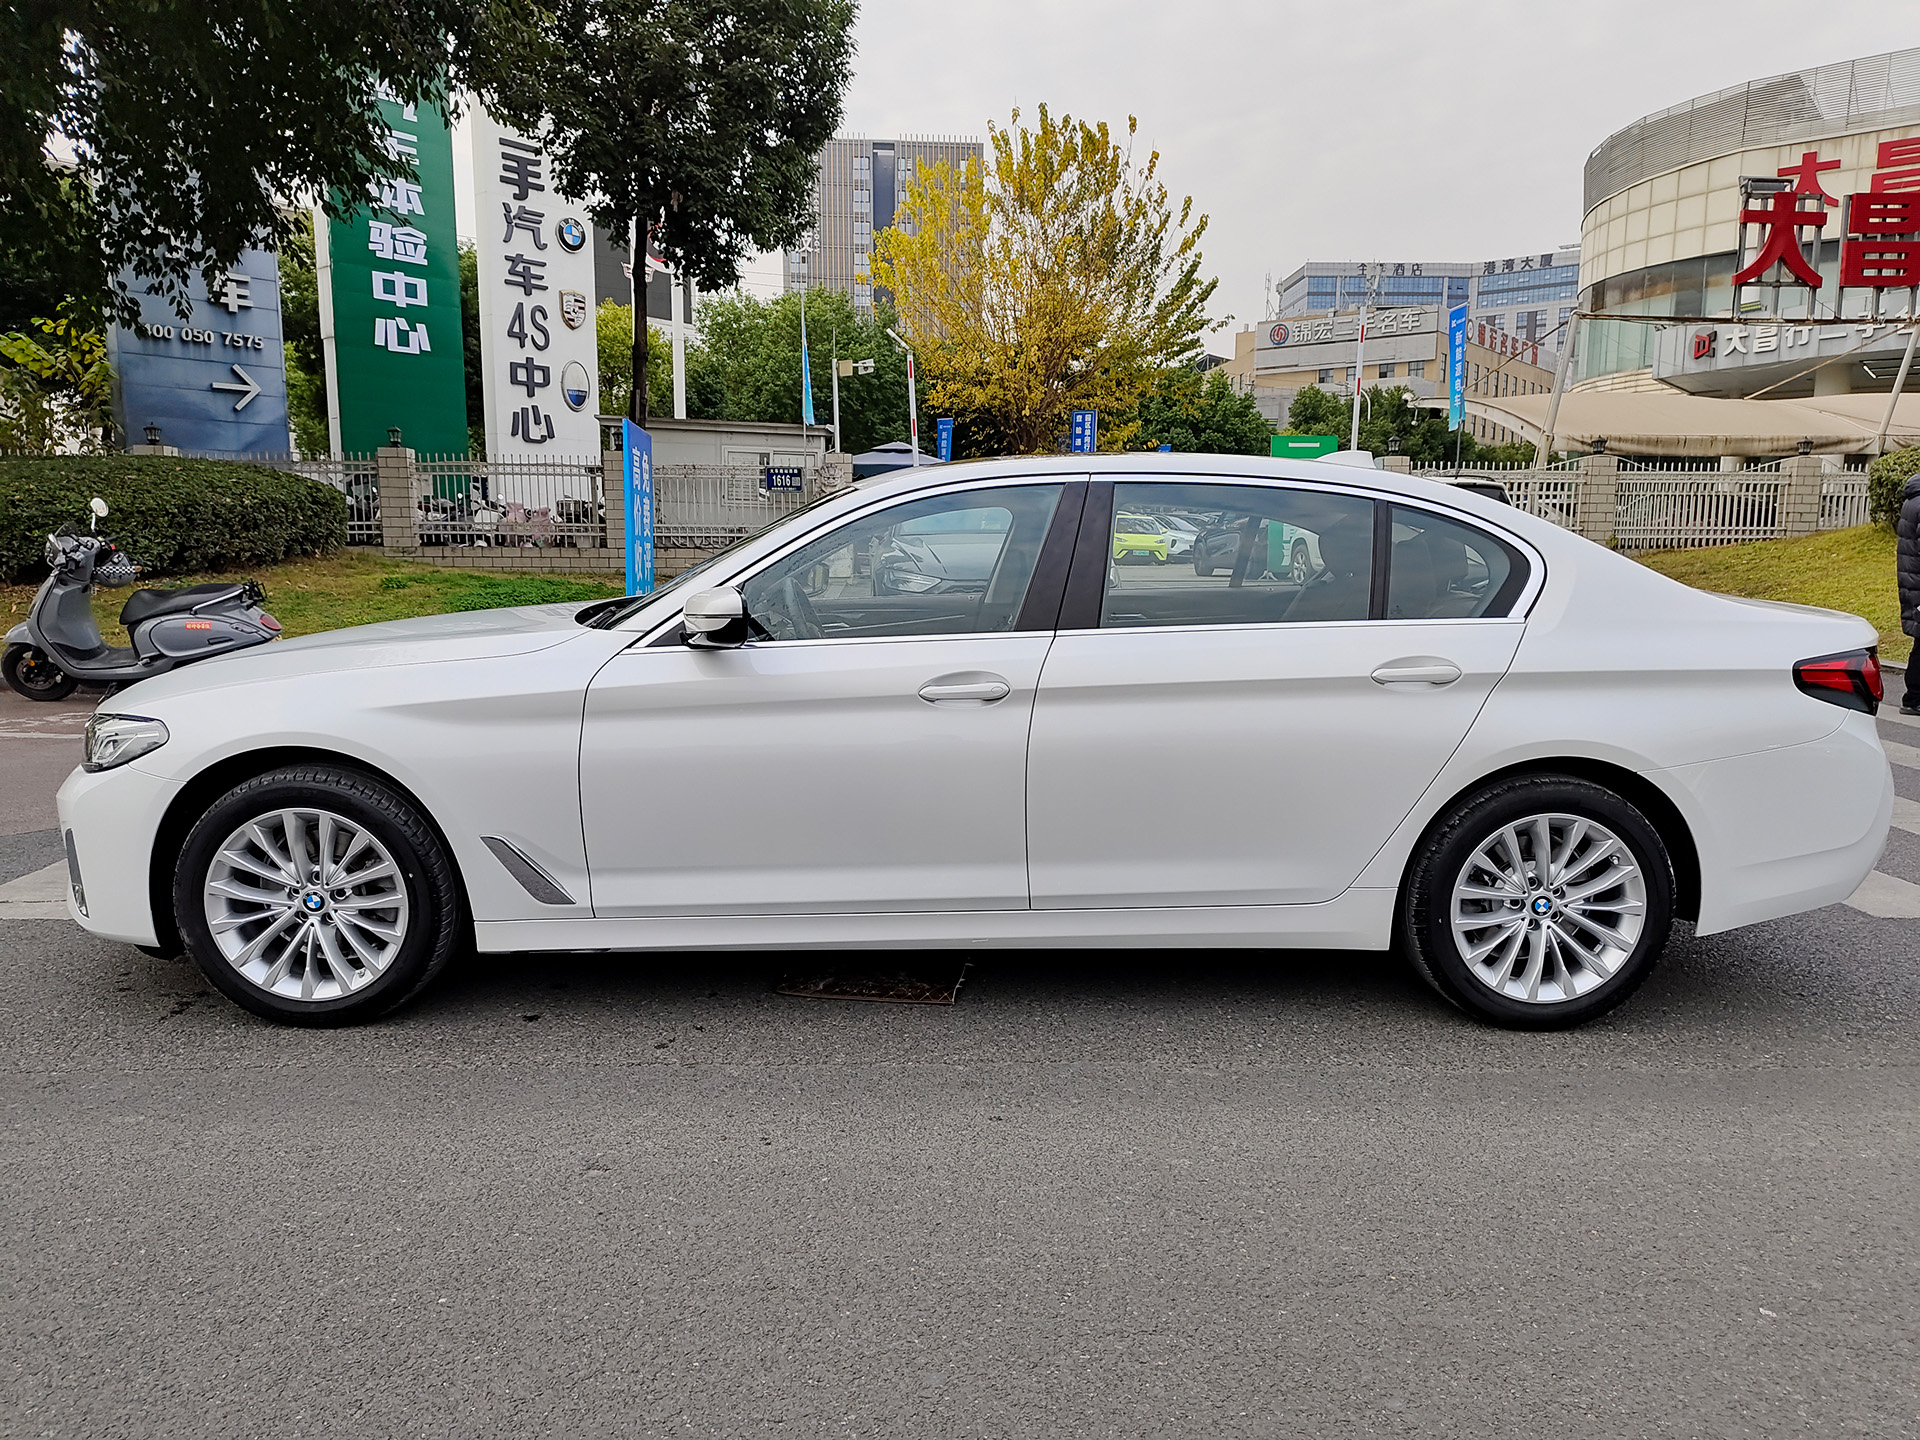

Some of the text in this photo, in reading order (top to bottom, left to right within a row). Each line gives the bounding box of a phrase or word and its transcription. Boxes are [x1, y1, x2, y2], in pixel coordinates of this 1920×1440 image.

[1357, 263, 1422, 276] 全酒店
[1482, 253, 1554, 275] 港湾大厦
[1292, 307, 1421, 343] 锦宏二手名车
[181, 328, 214, 344] 050
[222, 332, 264, 349] 7575
[772, 475, 791, 486] 1616
